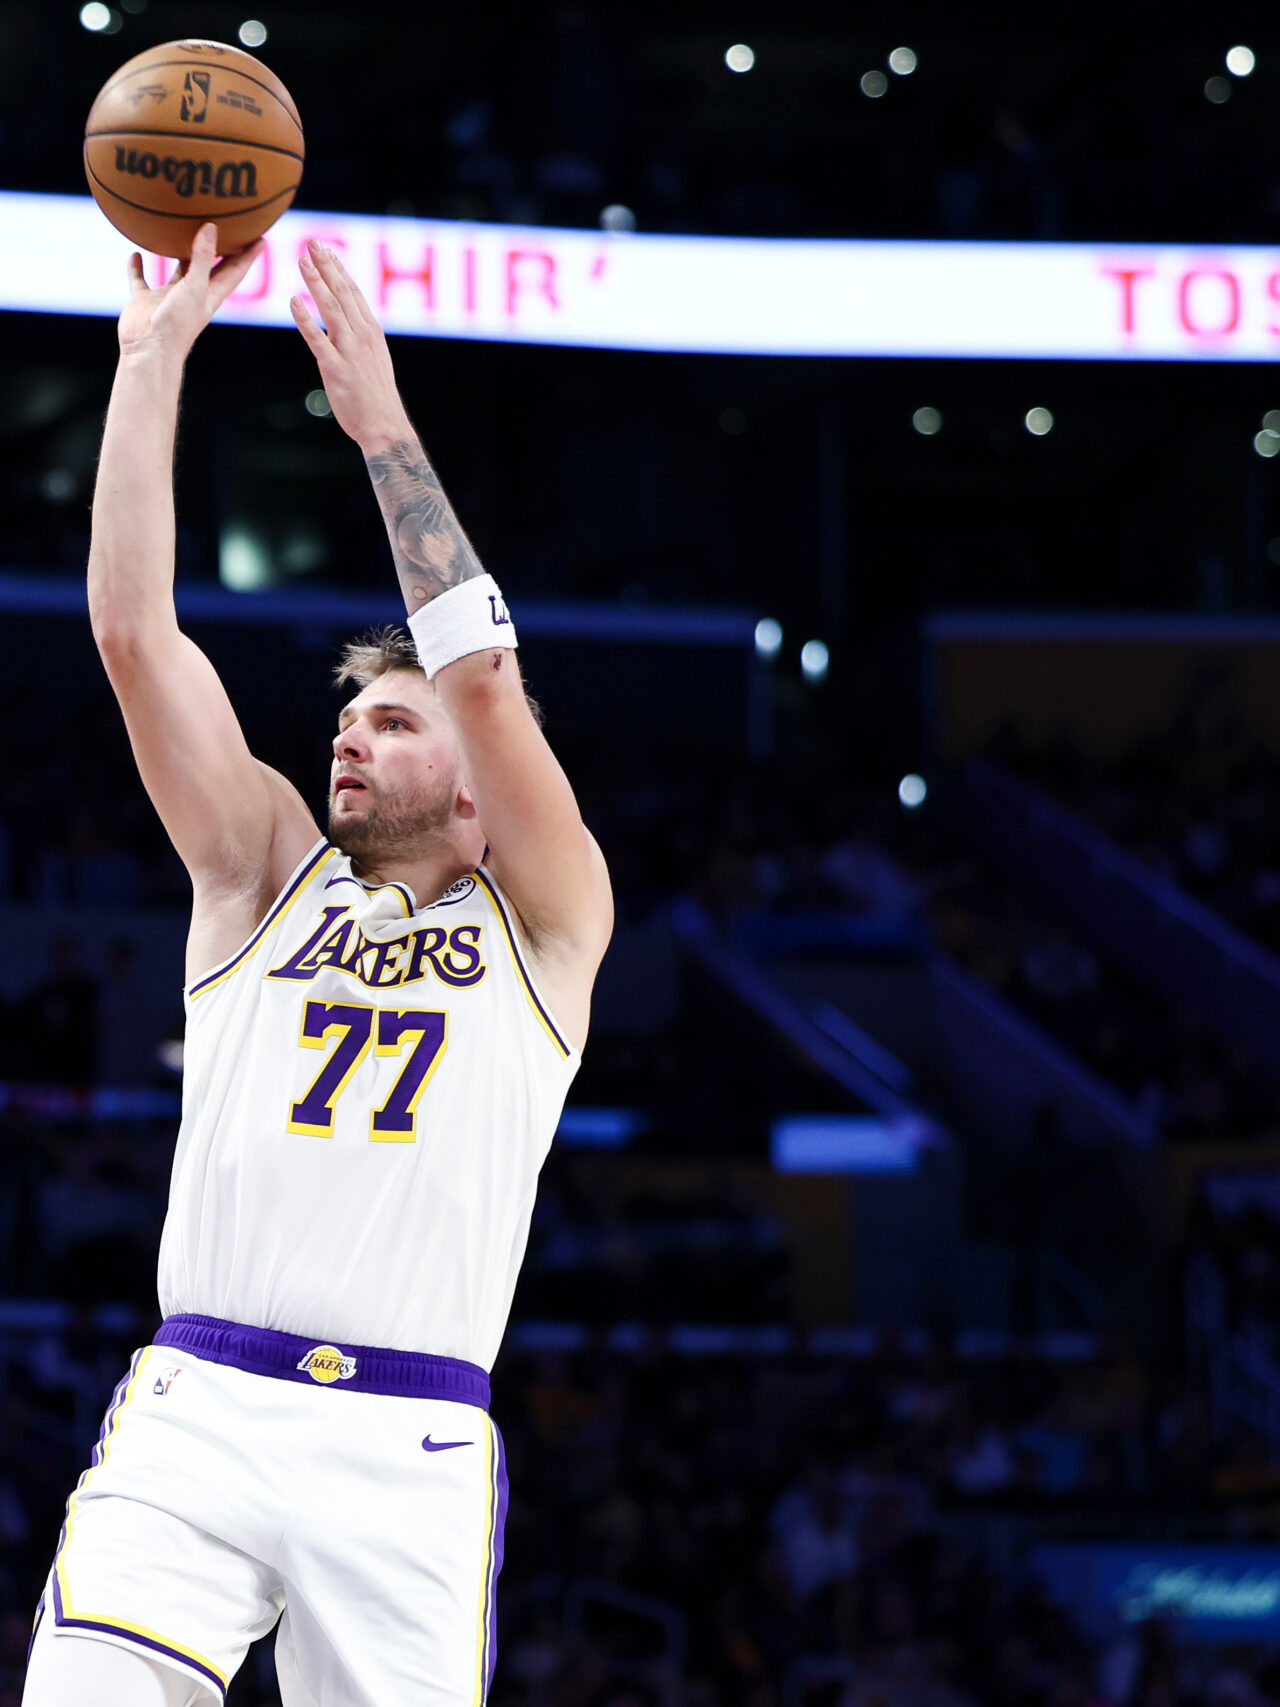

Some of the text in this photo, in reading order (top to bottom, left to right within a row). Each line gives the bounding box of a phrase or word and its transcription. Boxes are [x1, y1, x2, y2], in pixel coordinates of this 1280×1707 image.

[114, 145, 258, 197] Wilson
[263, 904, 488, 990] LAKERS
[286, 997, 450, 1143] 77
[301, 1352, 357, 1378] LAKERS
